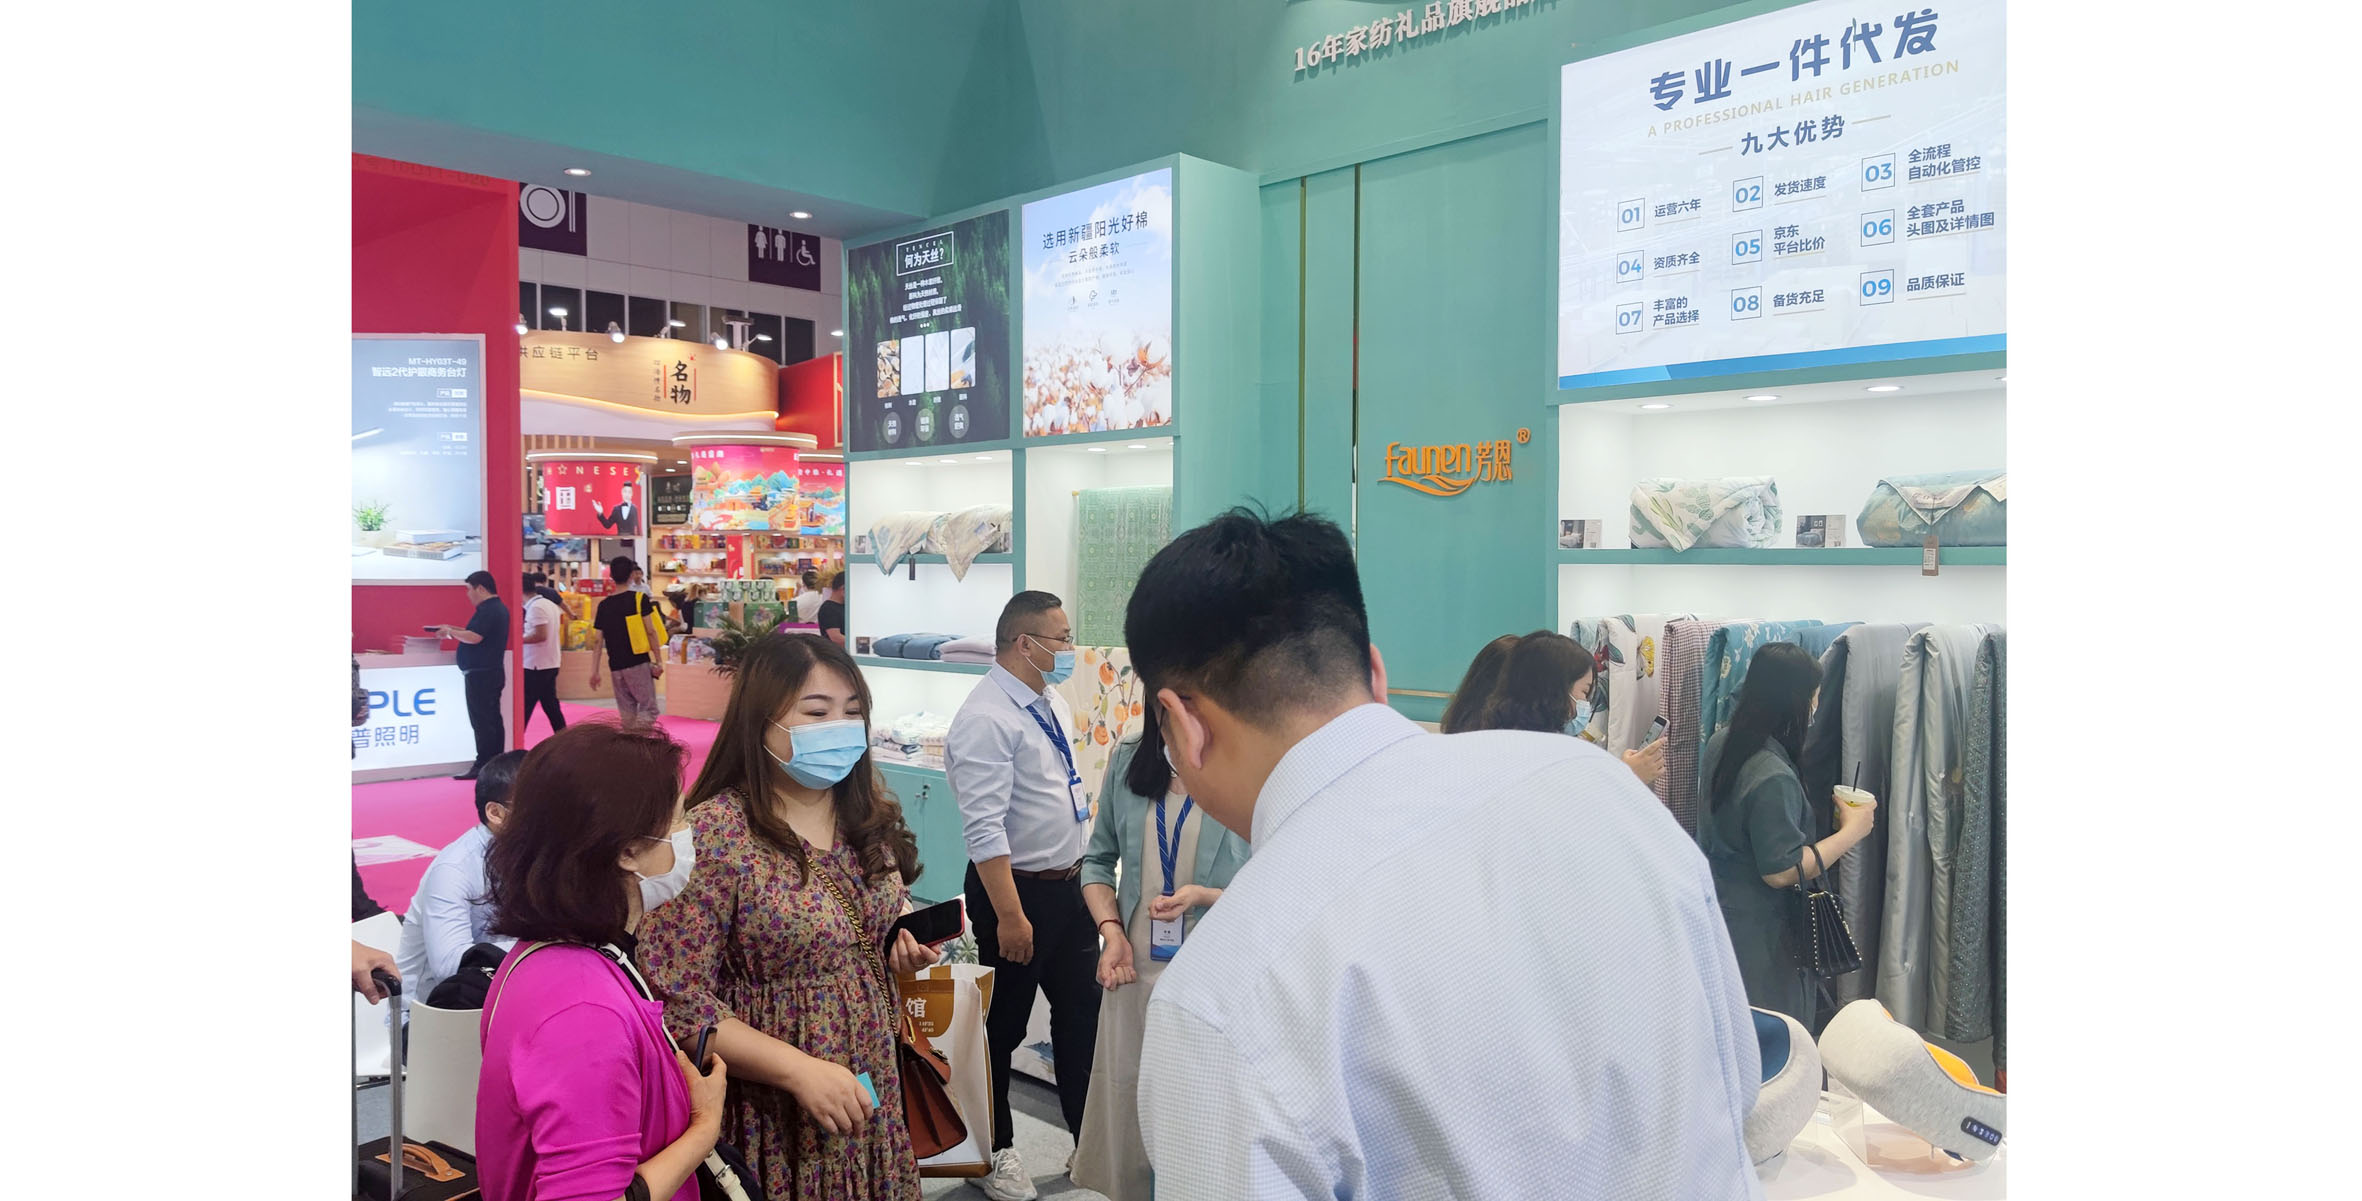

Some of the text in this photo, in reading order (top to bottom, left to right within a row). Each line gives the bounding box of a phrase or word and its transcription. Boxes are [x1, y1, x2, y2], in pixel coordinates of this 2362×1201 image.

[1294, 0, 1536, 72] 16年家纺礼品旗舰
[1649, 8, 1939, 112] 专业一件代发
[1647, 60, 1960, 138] A PROFESSIONAL HAIR GENERATION
[1740, 114, 1846, 156] 九大优势
[1907, 143, 1952, 164] 全流程
[1864, 162, 1893, 183] 03
[1908, 156, 1982, 181] 自动化管控
[1735, 185, 1761, 204] 02
[1773, 175, 1827, 197] 发货速度
[1621, 206, 1640, 224] 01
[1653, 198, 1702, 218] 运营六年
[1906, 199, 1965, 221] 全套产品
[1042, 210, 1149, 250] 选用新疆阳光好棉
[1773, 224, 1800, 241] 京东
[1862, 218, 1892, 238] 06
[1906, 212, 1995, 238] 头图及详情图
[1068, 241, 1121, 264] 云朵般柔软
[1734, 238, 1761, 257] 05
[1773, 236, 1826, 256] 平台比价
[1618, 258, 1642, 276] 04
[1653, 251, 1701, 270] 资质齐全
[1862, 278, 1892, 298] 09
[1906, 272, 1966, 293] 品质保证
[1653, 296, 1689, 312] 丰富的
[1733, 294, 1760, 313] 08
[1772, 289, 1825, 308] 备货充足
[1618, 309, 1642, 327] 07
[1652, 309, 1700, 327] 产品选择
[669, 360, 692, 405] 名物
[1475, 440, 1513, 482] 芳恩
[352, 724, 420, 749] 普照明
